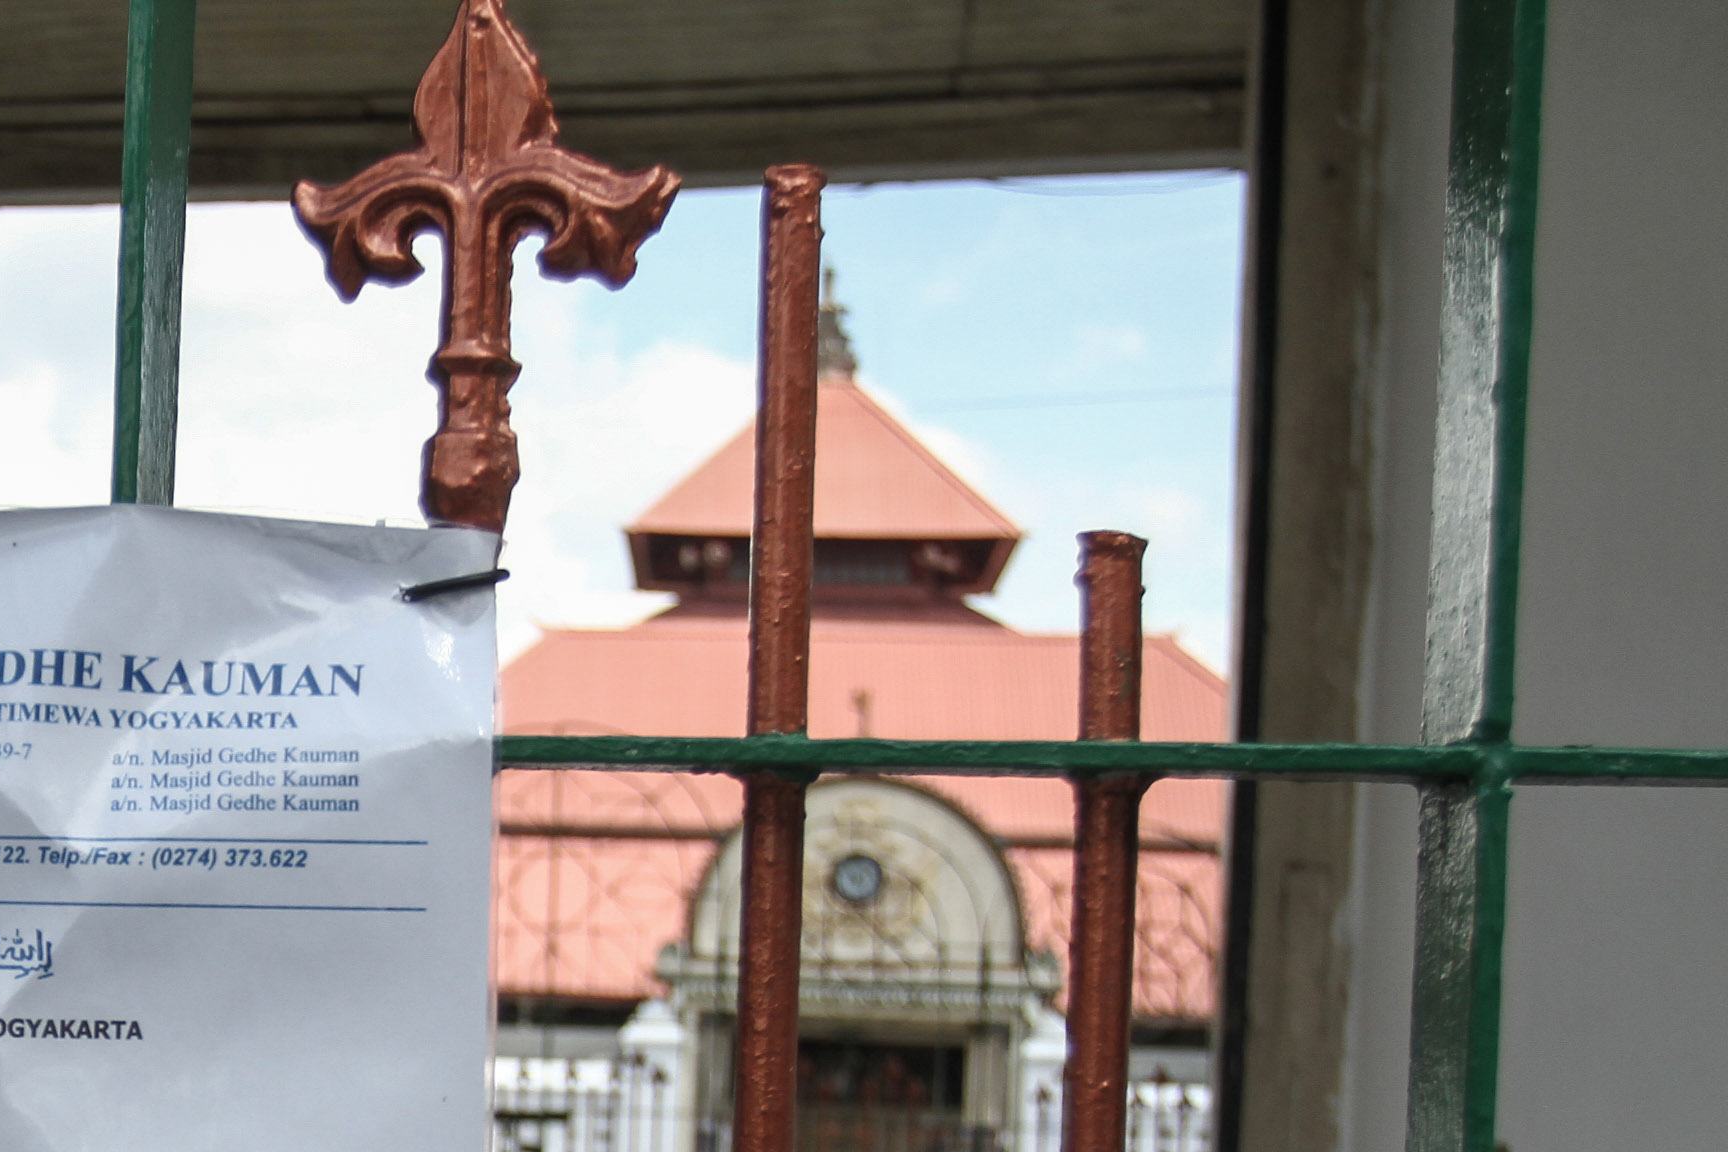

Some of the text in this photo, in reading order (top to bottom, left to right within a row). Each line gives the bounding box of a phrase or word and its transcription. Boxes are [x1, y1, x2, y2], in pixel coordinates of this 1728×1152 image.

[118, 654, 365, 697] KAUMAN
[109, 708, 298, 730] YOGYAKARTA
[112, 746, 360, 768] a/n. Masjid Gedhe Kauman
[38, 846, 132, 869] Telp./Fax
[152, 847, 218, 871] (0274)
[224, 848, 308, 868] 373.622
